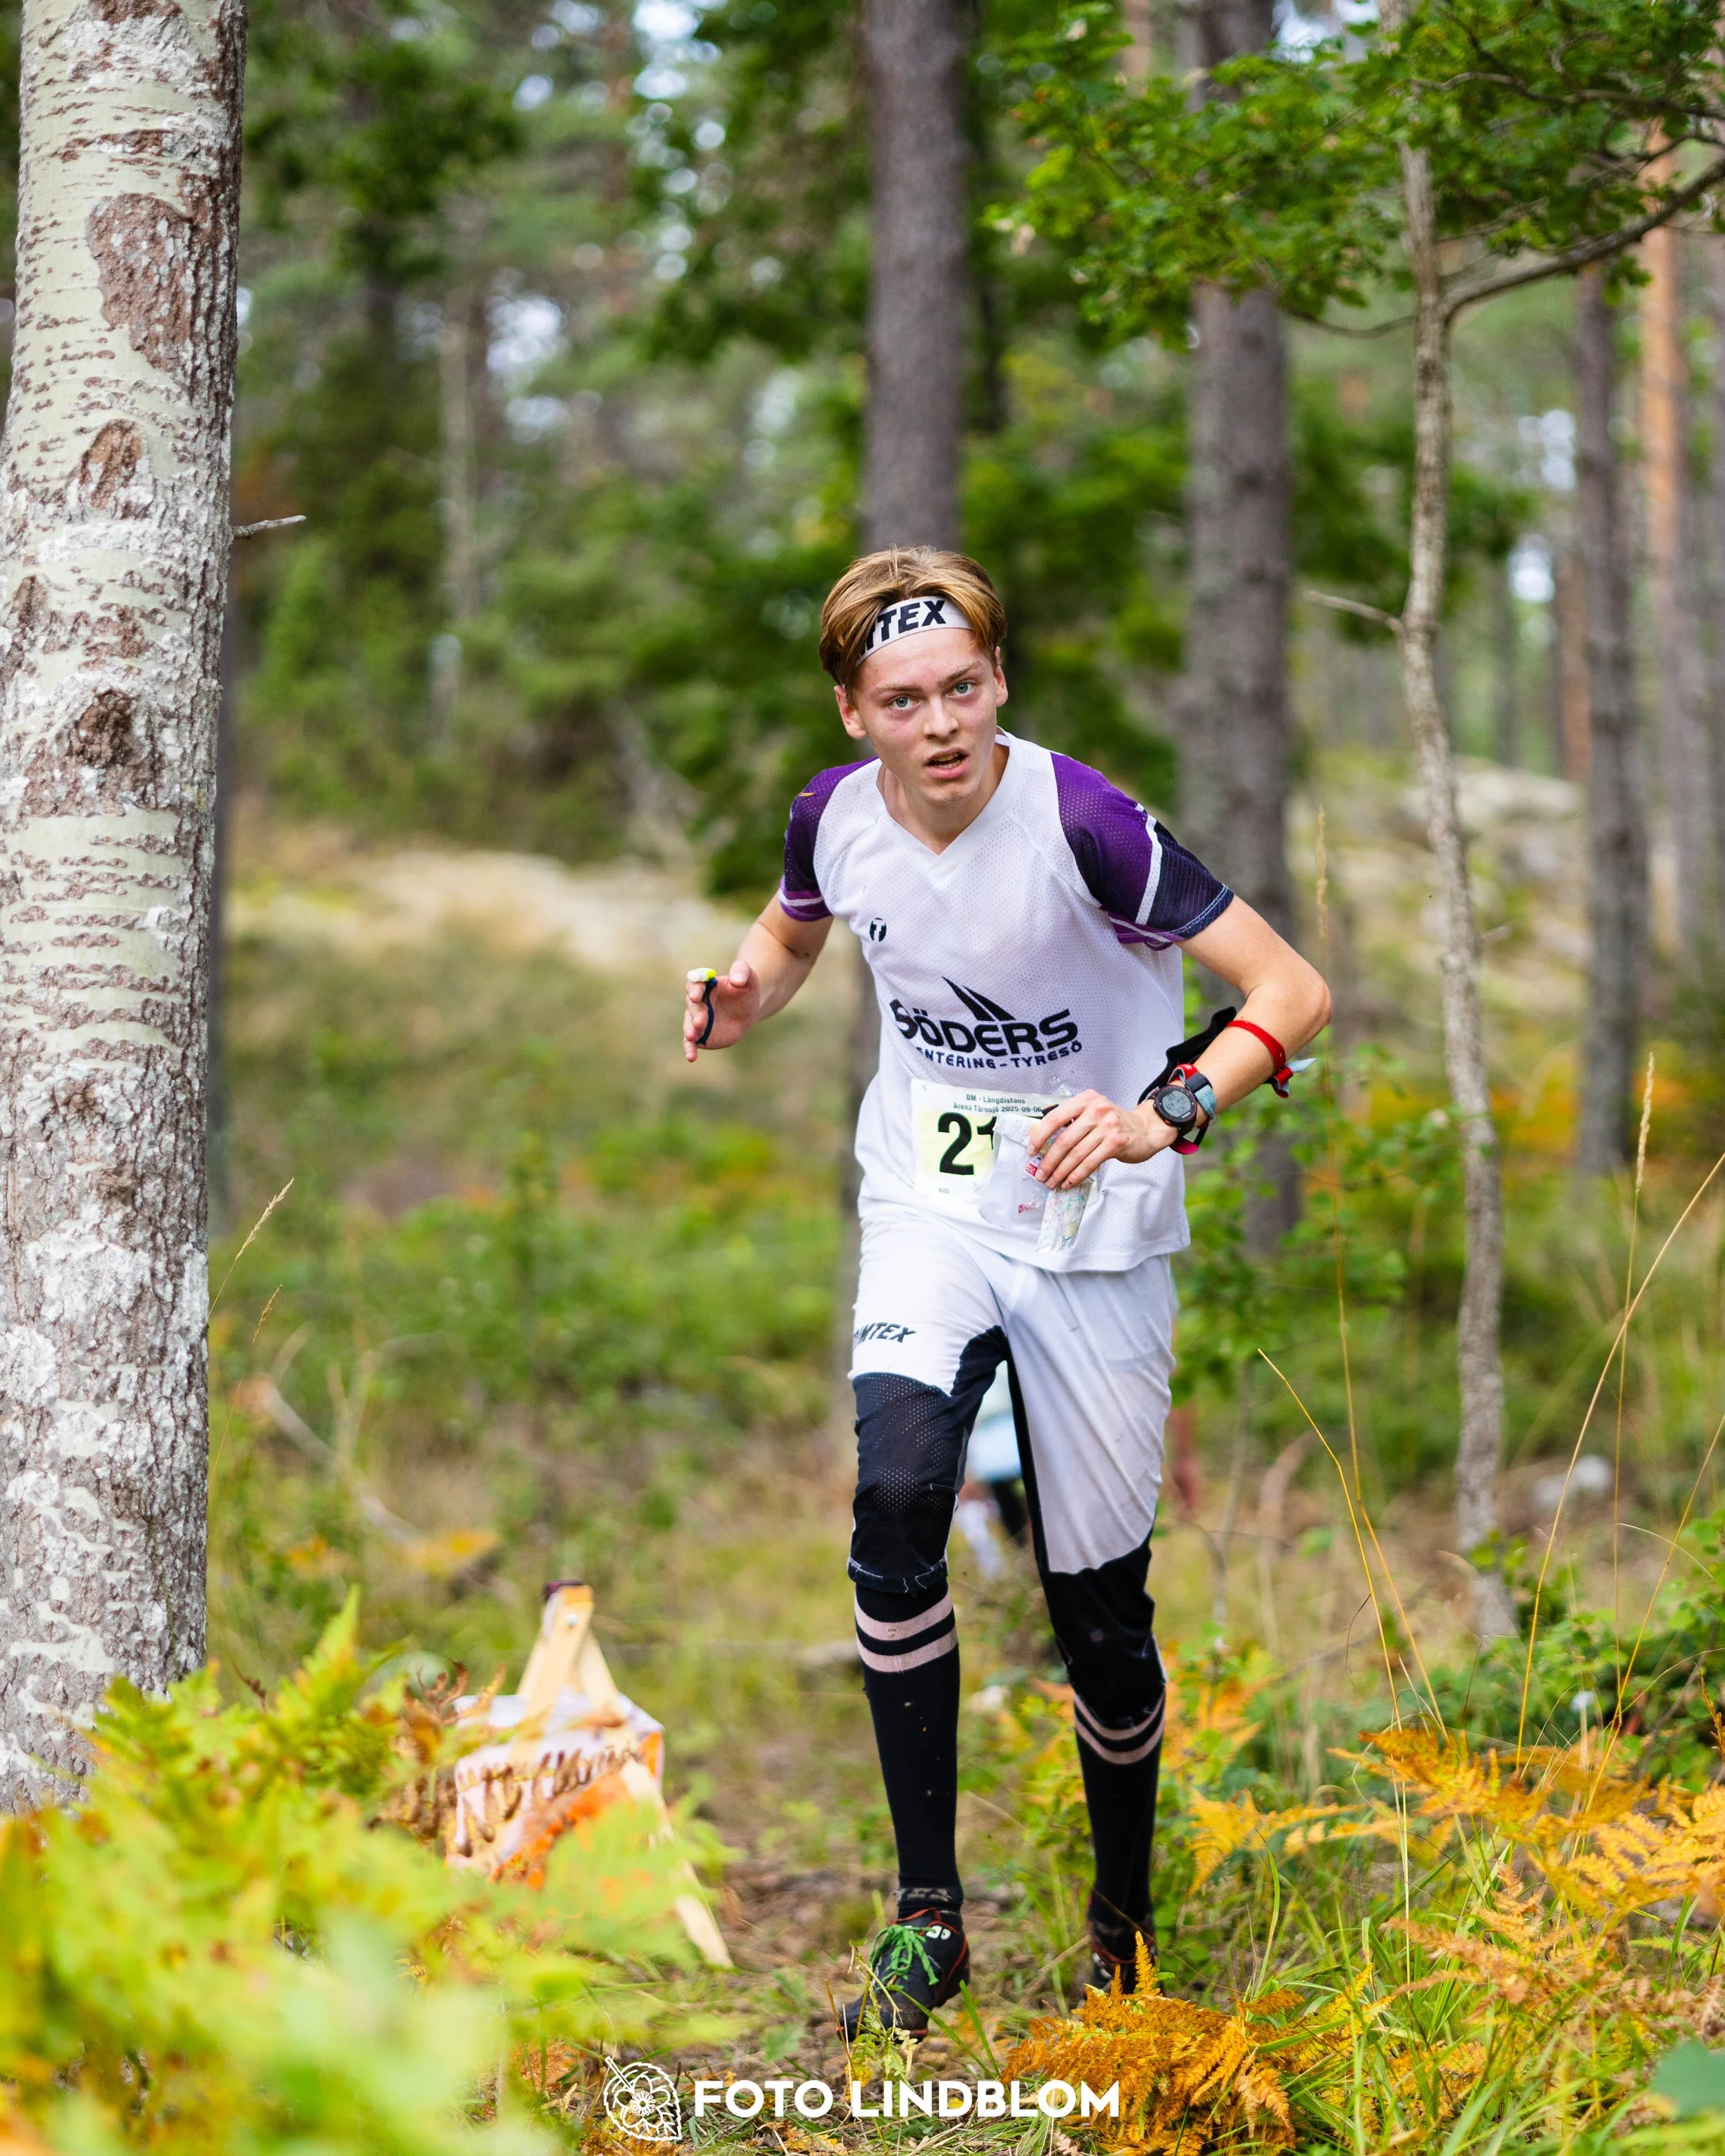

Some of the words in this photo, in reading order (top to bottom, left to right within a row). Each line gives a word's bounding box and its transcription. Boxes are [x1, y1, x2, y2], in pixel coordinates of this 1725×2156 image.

[889, 998, 1078, 1058] SÖDERS
[983, 1095, 1026, 1105] Långdistans
[954, 1102, 972, 1111] Arena
